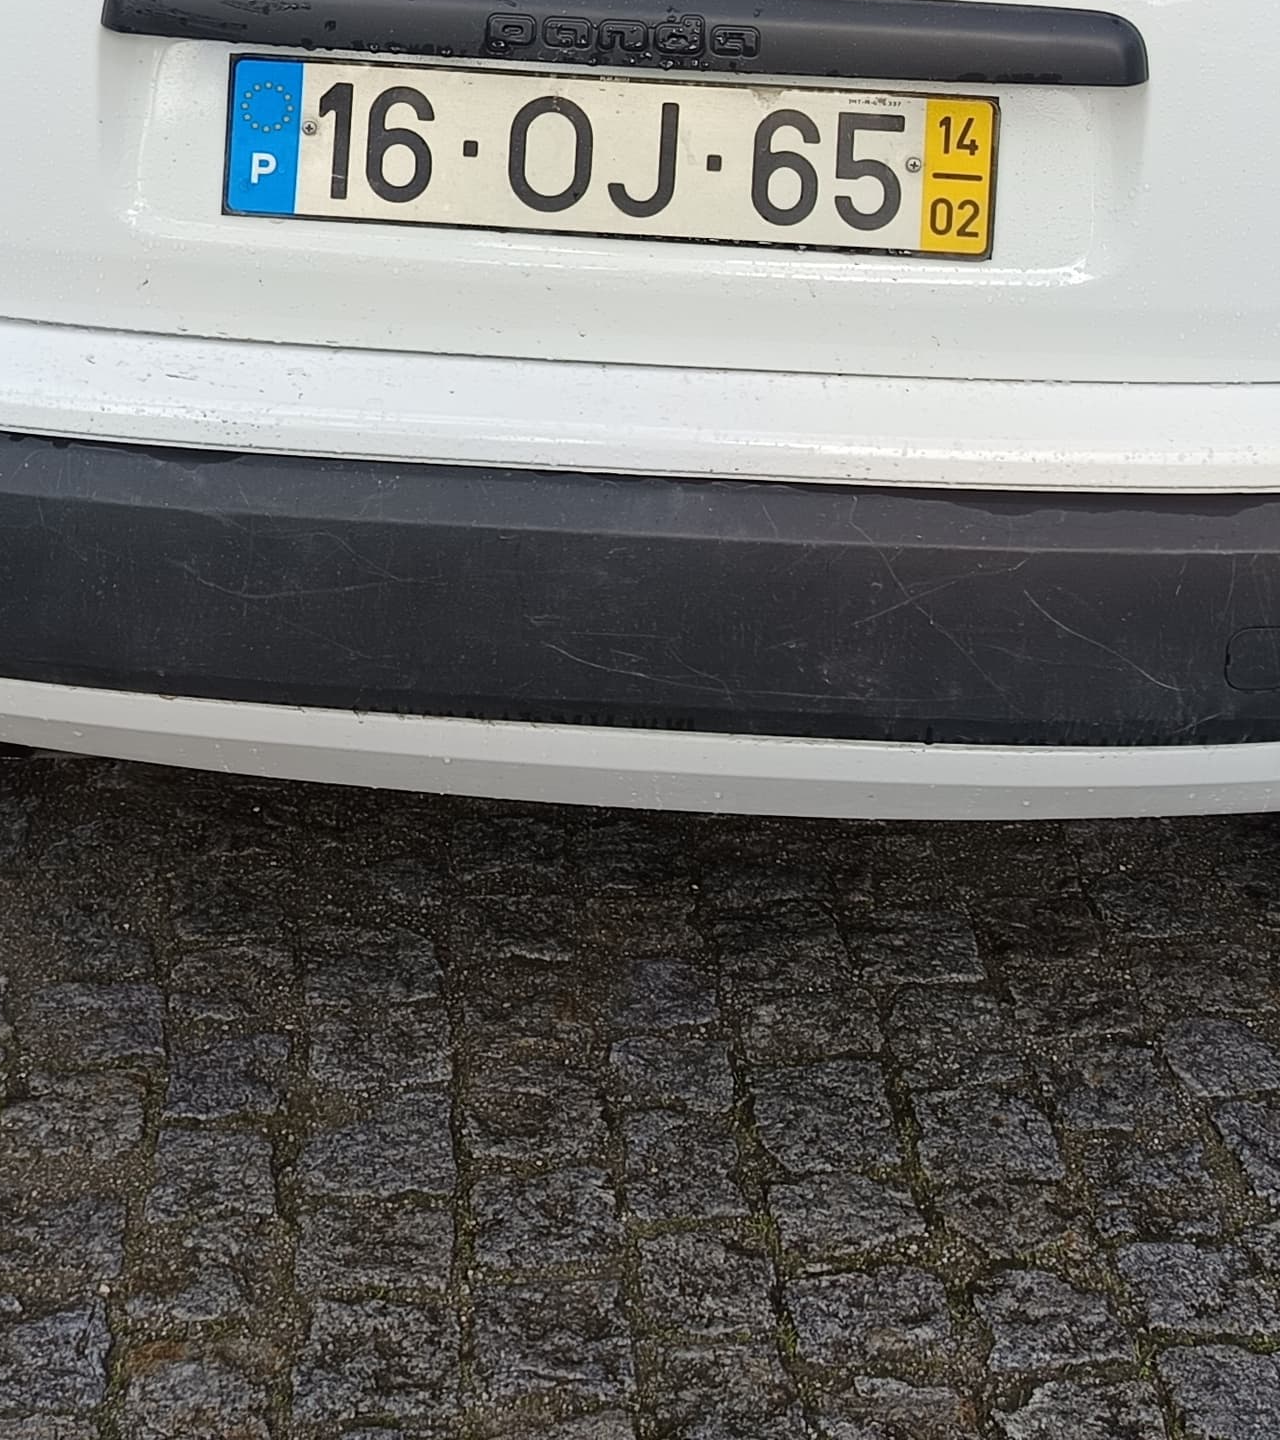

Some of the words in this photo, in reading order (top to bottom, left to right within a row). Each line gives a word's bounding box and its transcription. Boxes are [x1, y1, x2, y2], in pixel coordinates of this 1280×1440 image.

[484, 12, 761, 59] panda
[938, 115, 980, 157] 14
[249, 151, 278, 185] P
[929, 196, 981, 239] 02
